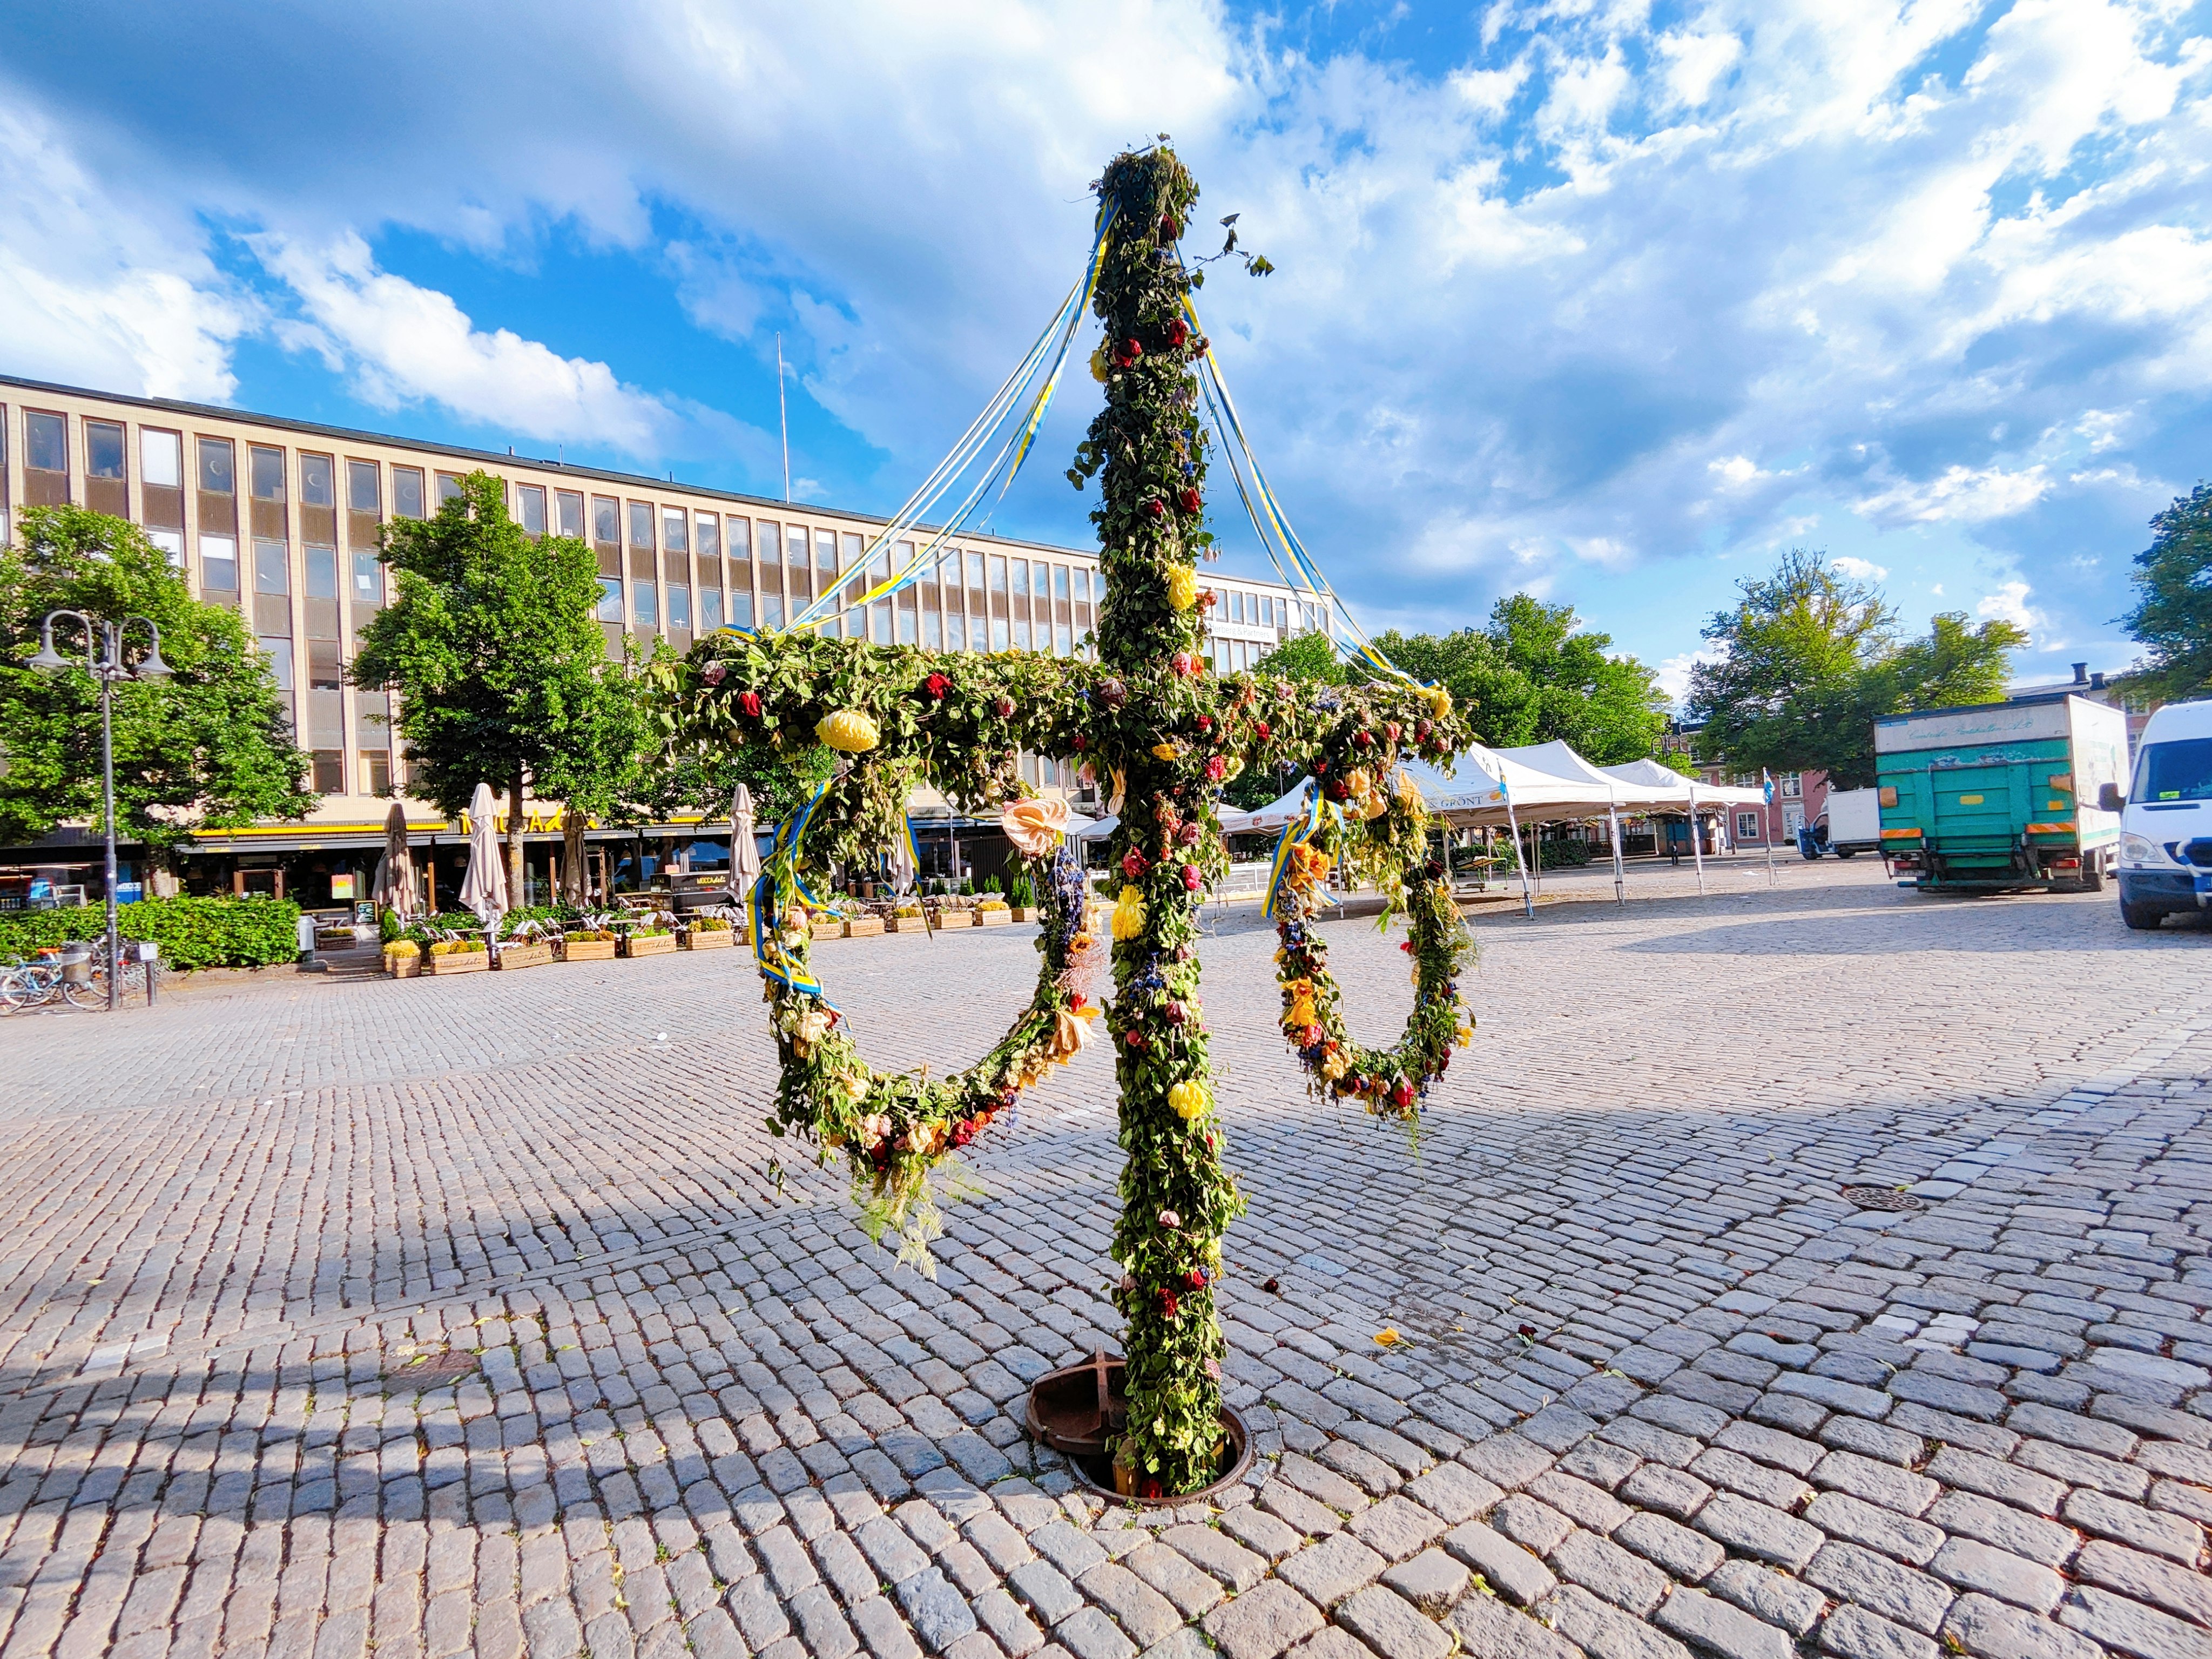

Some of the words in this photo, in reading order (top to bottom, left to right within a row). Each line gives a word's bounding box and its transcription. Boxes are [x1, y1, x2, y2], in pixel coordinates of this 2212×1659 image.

[1237, 626, 1243, 635] &
[1243, 628, 1270, 638] Partners
[1440, 796, 1483, 807] GRÖNT
[697, 875, 726, 884] MOCCAdeli
